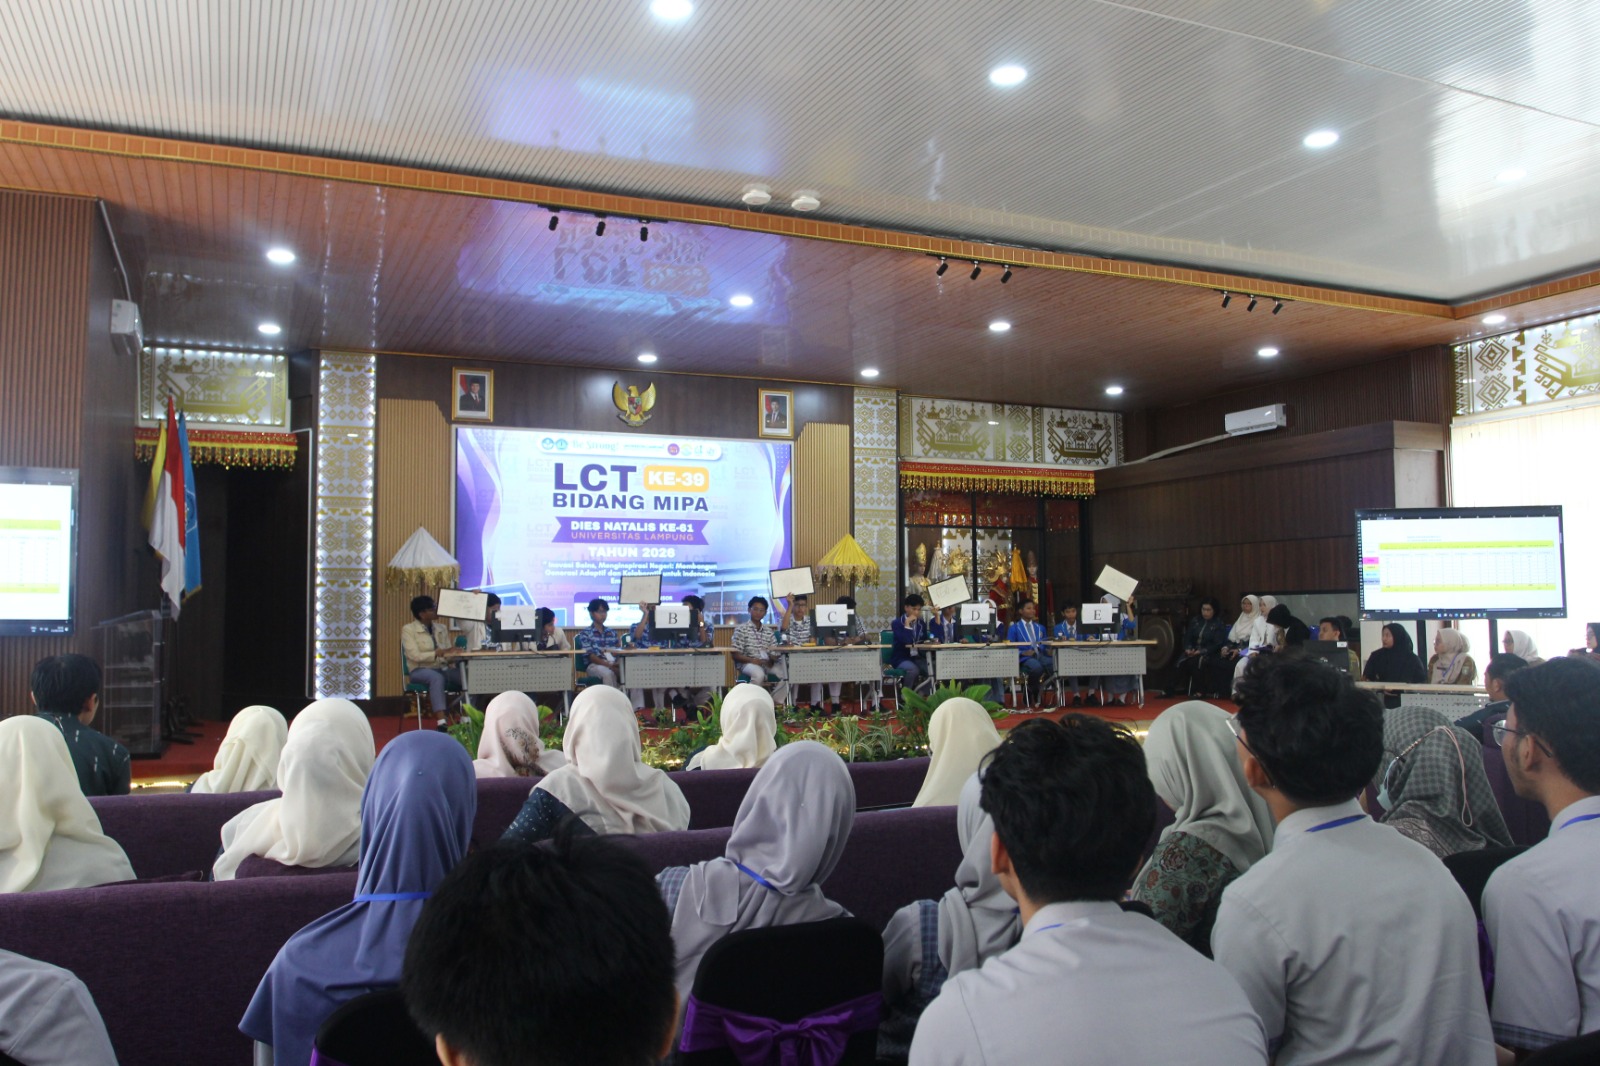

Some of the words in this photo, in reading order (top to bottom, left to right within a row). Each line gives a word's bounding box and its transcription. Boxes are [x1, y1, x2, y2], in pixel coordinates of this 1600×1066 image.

[554, 462, 637, 492] LCT
[649, 471, 705, 486] KE-39
[553, 492, 645, 510] BIDANG
[653, 496, 709, 512] MIPA
[570, 521, 600, 531] DIES
[604, 522, 656, 532] NATALIS
[659, 523, 694, 533] KE-61
[571, 532, 640, 540] UNIVERSITAS
[588, 547, 638, 557] TAHUN
[642, 547, 676, 558] 2026
[598, 562, 648, 571] Menginspirasi
[675, 562, 717, 571] Membangun
[579, 570, 606, 578] Adaptif
[513, 613, 525, 625] A
[668, 612, 678, 625] B
[827, 610, 838, 622] C
[970, 609, 981, 621] D
[1093, 609, 1103, 621] E
